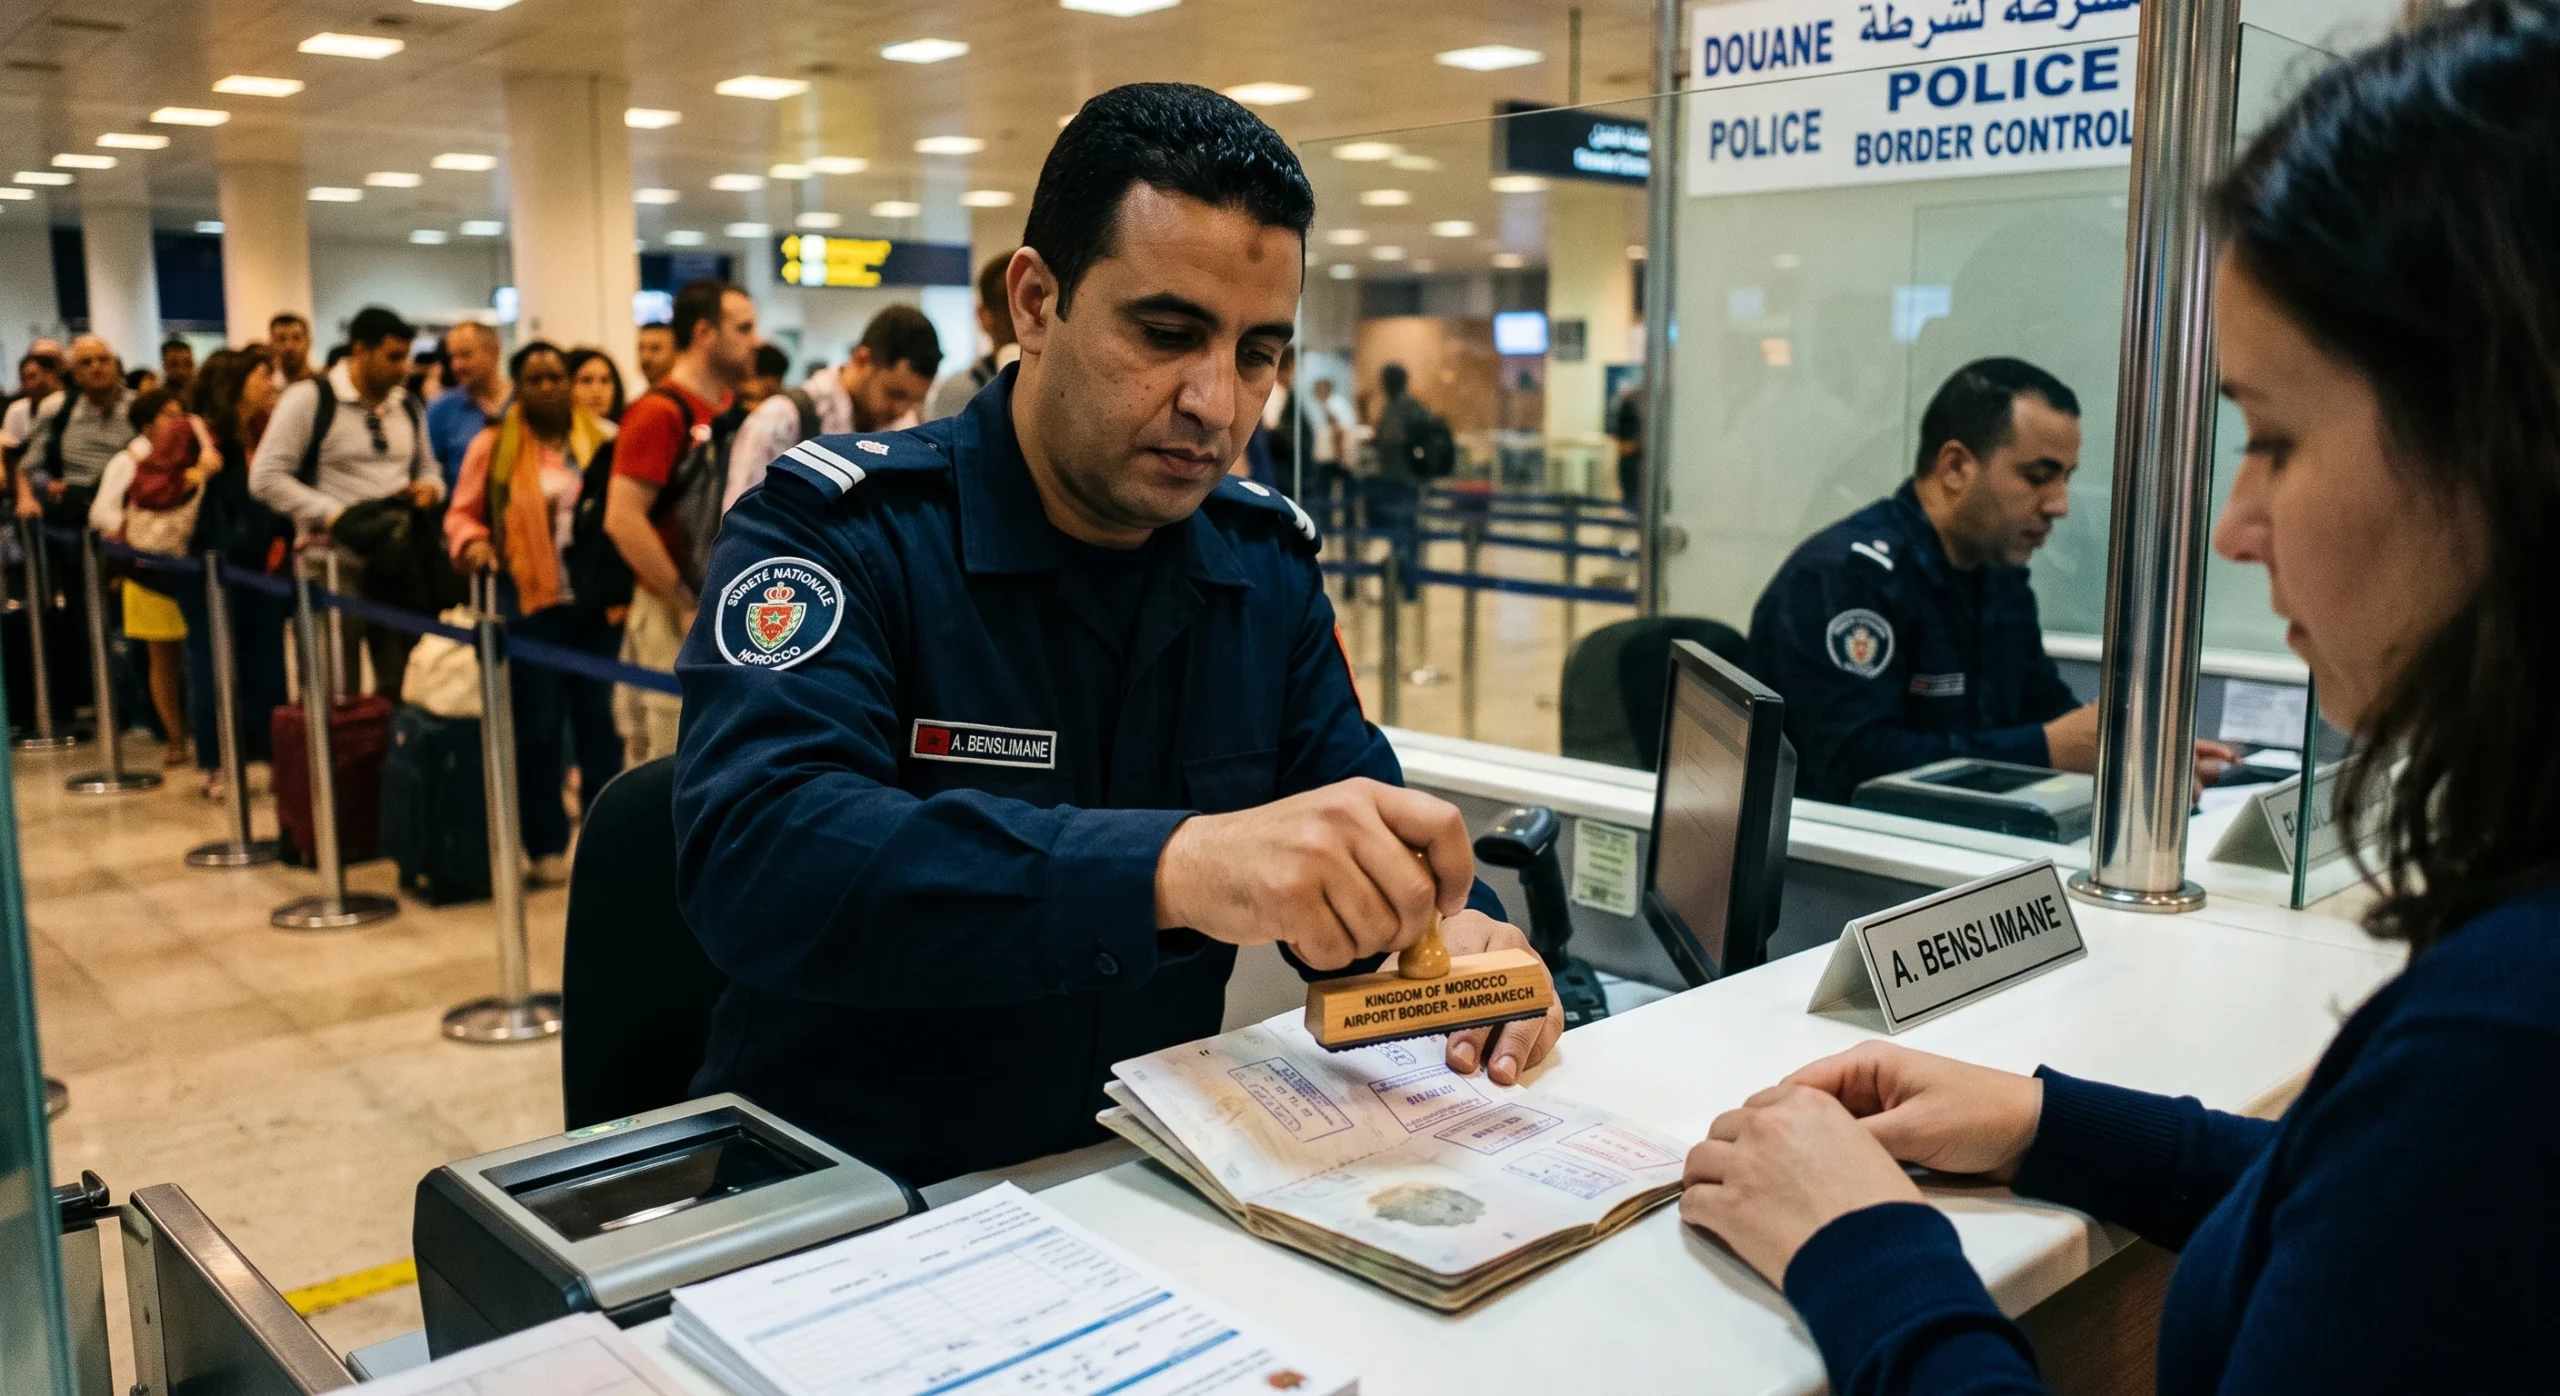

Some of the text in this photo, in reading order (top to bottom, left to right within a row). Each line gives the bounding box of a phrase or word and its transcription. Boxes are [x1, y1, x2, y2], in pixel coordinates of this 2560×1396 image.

[1703, 19, 1834, 77] DOUANE
[1888, 47, 2120, 112] POLICE
[1709, 109, 1822, 161] POLICE
[1854, 108, 2134, 168] BORDER CONTROL
[774, 568, 835, 607] NATIONALE
[738, 646, 801, 665] MOROCCO
[950, 734, 1049, 758] A. BENSLIMANE
[1892, 895, 2062, 988] A. BENSLIMANE
[1343, 1007, 1396, 1029] AIRPORT
[1398, 1000, 1449, 1020] BORDER
[1458, 986, 1535, 1010] MARRAKECH
[1365, 974, 1508, 1009] KINGDOM OF MOROCCO
